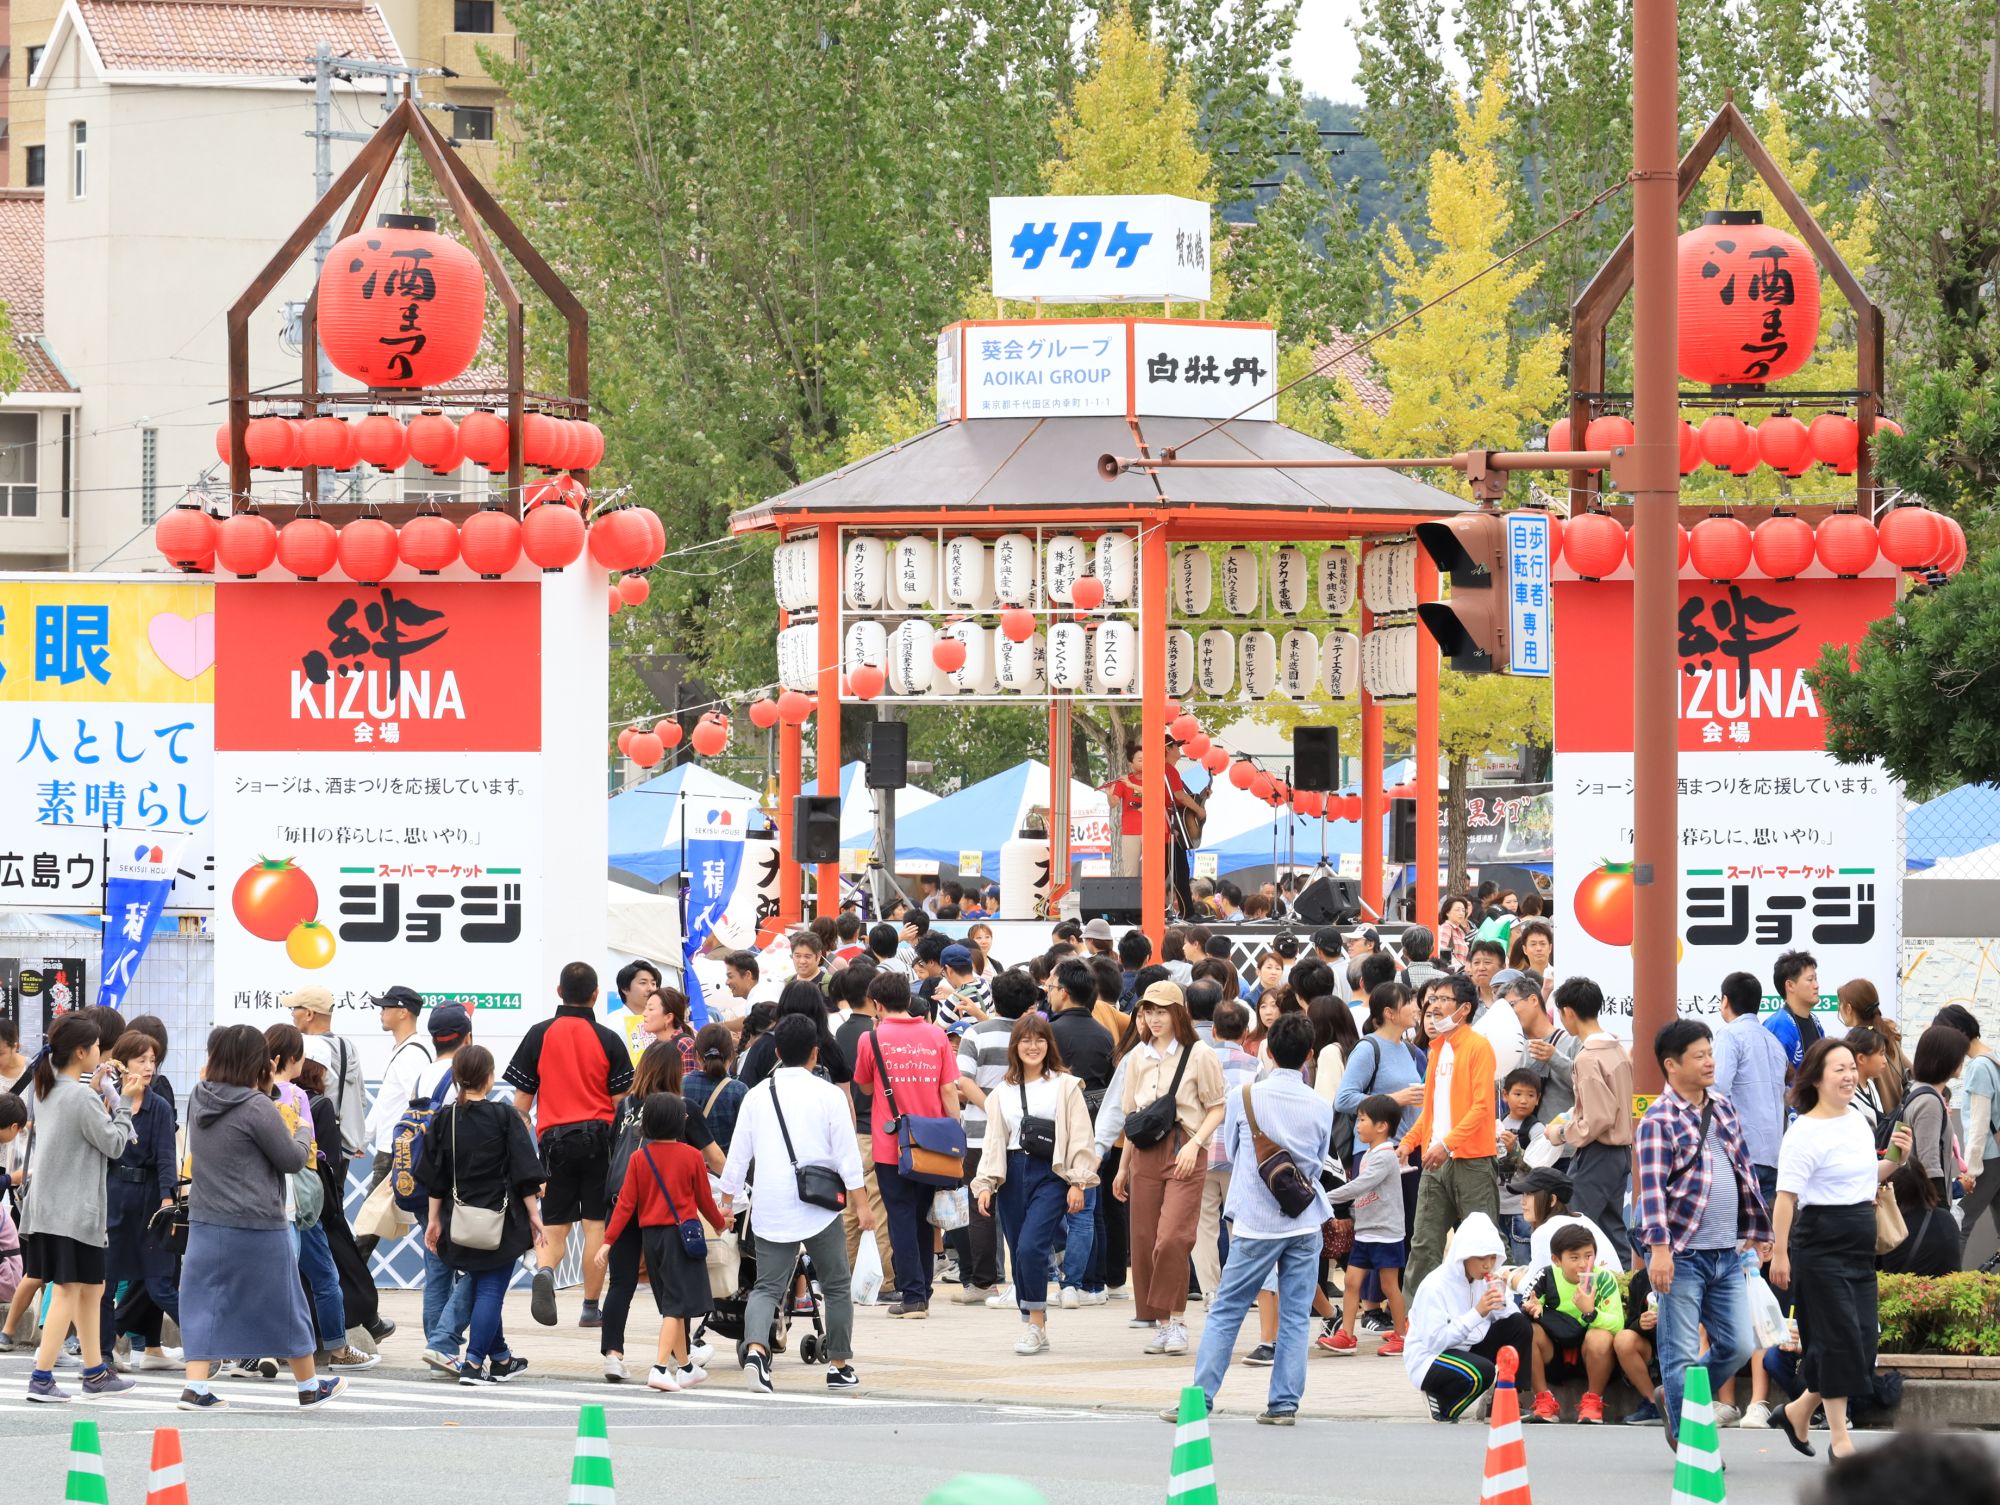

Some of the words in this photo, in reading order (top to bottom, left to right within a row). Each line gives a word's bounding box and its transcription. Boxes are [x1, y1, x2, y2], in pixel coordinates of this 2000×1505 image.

[1009, 221, 1153, 270] サタケ
[981, 336, 1113, 361] 葵会グループ
[983, 369, 1042, 386] AOIKAI
[1050, 367, 1111, 385] GROUP
[1147, 353, 1268, 386] 白牡丹
[982, 397, 1081, 410] 東京都千代田区内幸町
[1085, 397, 1110, 408] 1-1-1
[1514, 525, 1528, 605] 自転車
[1529, 526, 1544, 607] 歩行者
[1523, 612, 1538, 665] 専用
[290, 670, 467, 720] KIZUNA
[16, 717, 195, 765] 人として
[353, 722, 401, 743] 会場
[1701, 721, 1751, 743] 会場
[234, 776, 524, 796] ショージは、酒まつりを応援しています。
[694, 827, 720, 835] SEKISUI
[720, 828, 741, 836] HOUSE
[378, 864, 483, 878] スーパーマーケット
[1727, 865, 1835, 879] スーパーマーケット
[339, 882, 522, 943] ショージ
[1686, 884, 1875, 945] ショージ
